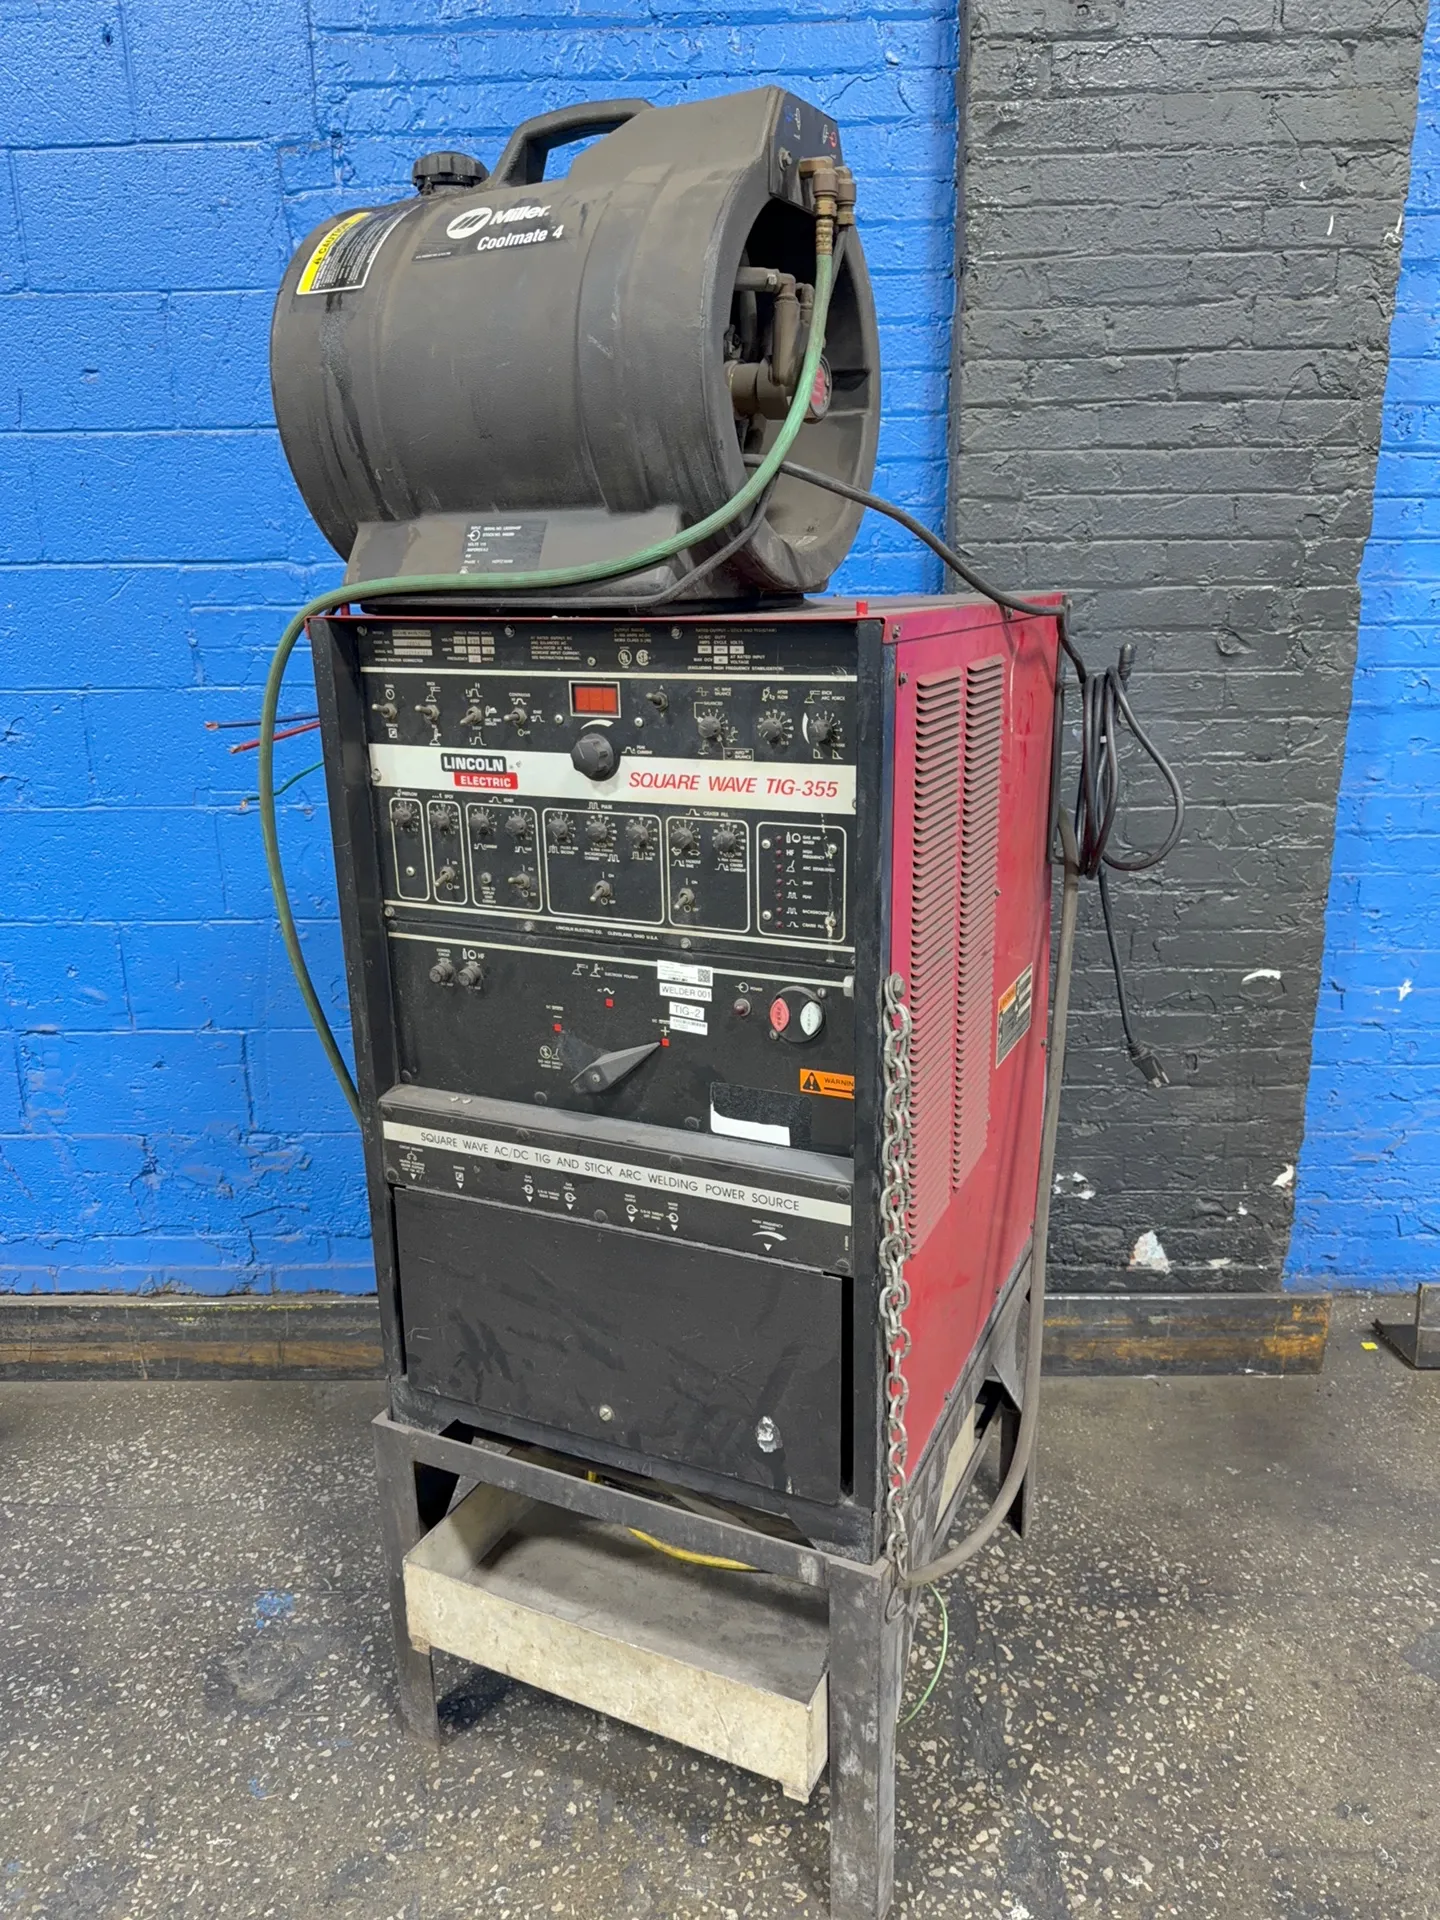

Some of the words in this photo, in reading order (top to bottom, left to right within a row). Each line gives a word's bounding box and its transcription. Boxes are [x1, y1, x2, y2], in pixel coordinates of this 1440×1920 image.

[477, 229, 548, 251] Coolmate
[552, 225, 564, 239] 4
[443, 756, 504, 772] LINCOLN
[460, 775, 511, 788] ELECTRIC
[629, 771, 700, 791] SQUARE
[708, 776, 757, 793] WAVE
[766, 777, 838, 798] TIG-355
[662, 986, 695, 997] WELDER
[697, 988, 711, 999] 001
[674, 1004, 701, 1018] TIG-2
[824, 1077, 854, 1087] WARNIN
[420, 1132, 458, 1148] SQUARE
[462, 1139, 489, 1153] WAVE
[494, 1145, 529, 1160] AC/DC
[534, 1152, 551, 1164] TIG
[556, 1157, 579, 1169] AND
[584, 1161, 613, 1176] STICK
[619, 1168, 642, 1181] ARC
[647, 1173, 698, 1191] WELDING
[705, 1184, 745, 1201] POWER
[752, 1193, 800, 1211] SOURCE
